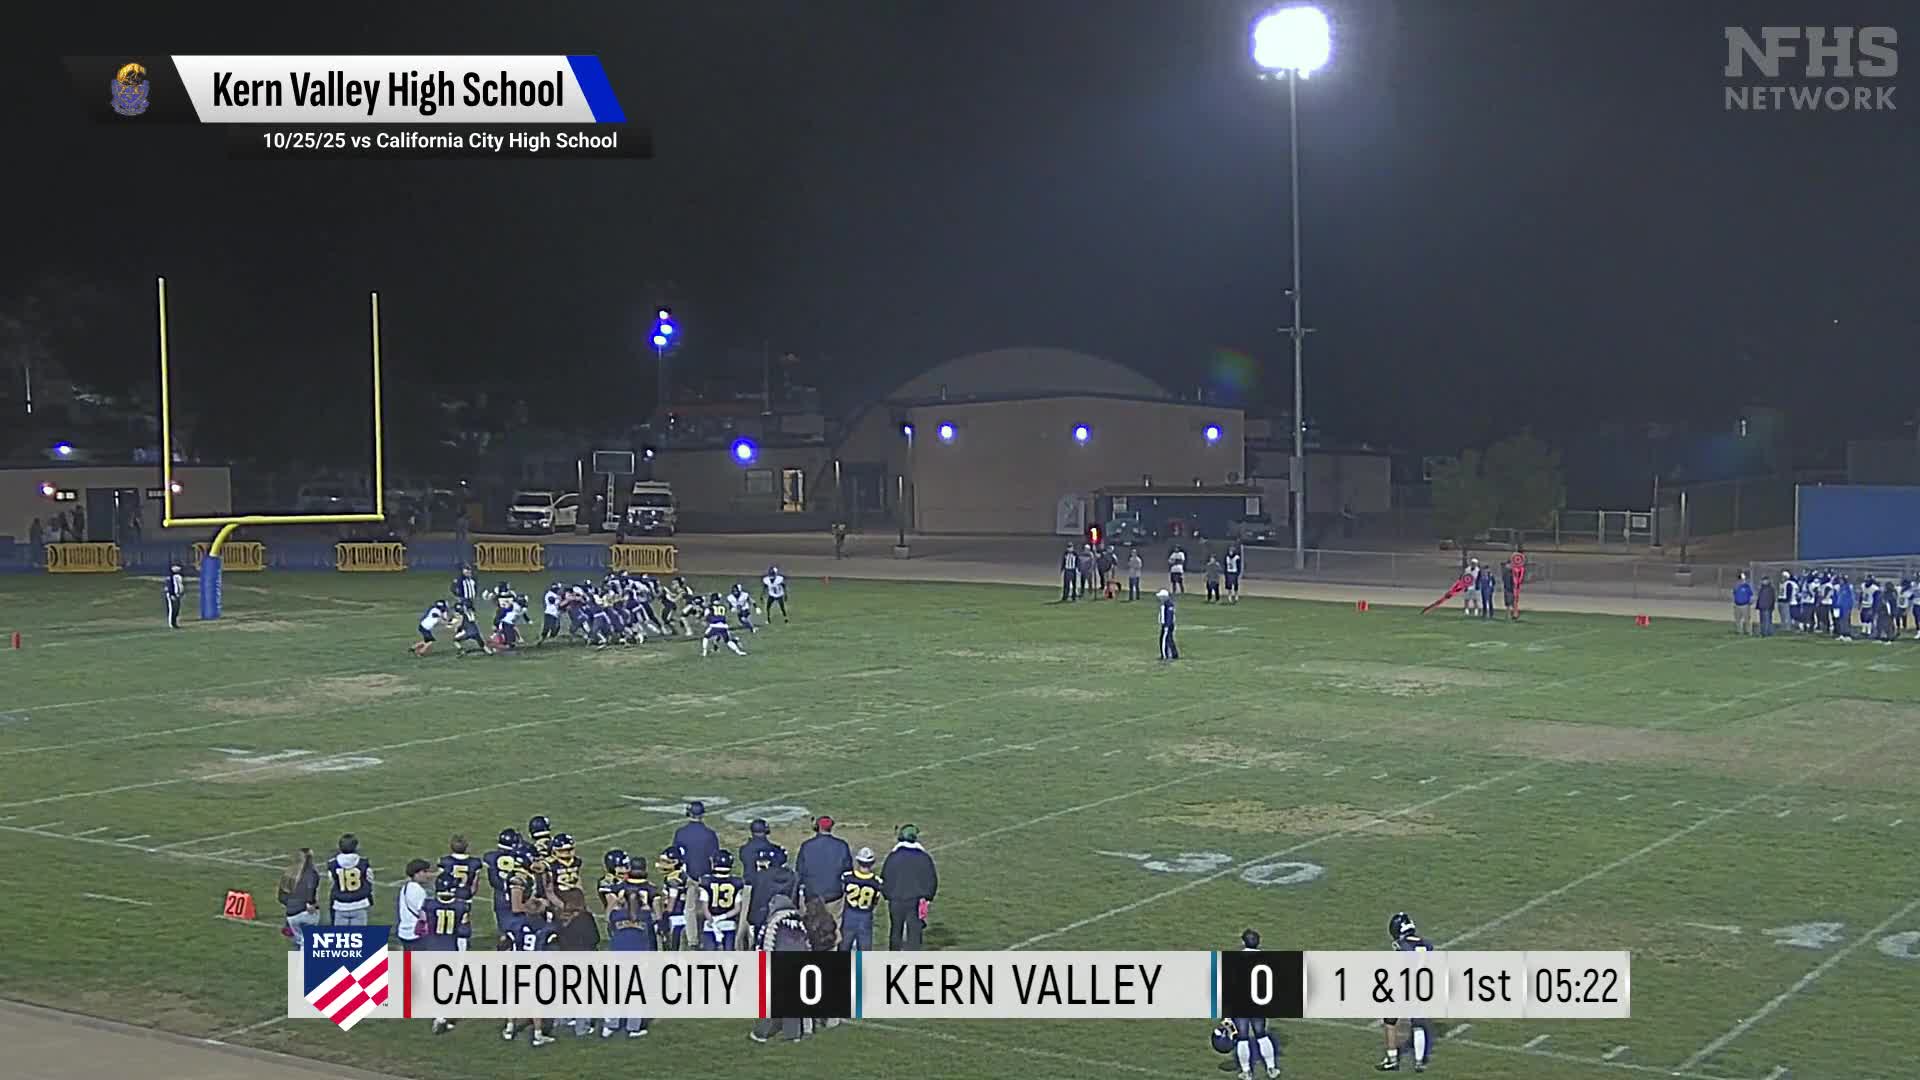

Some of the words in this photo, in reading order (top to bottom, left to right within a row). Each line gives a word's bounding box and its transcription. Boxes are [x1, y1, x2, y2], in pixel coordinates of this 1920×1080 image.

[335, 867, 362, 892] 18
[225, 895, 246, 916] 20
[710, 882, 735, 909] 13
[846, 883, 875, 910] 28
[436, 909, 456, 935] 11
[523, 934, 537, 951] 9
